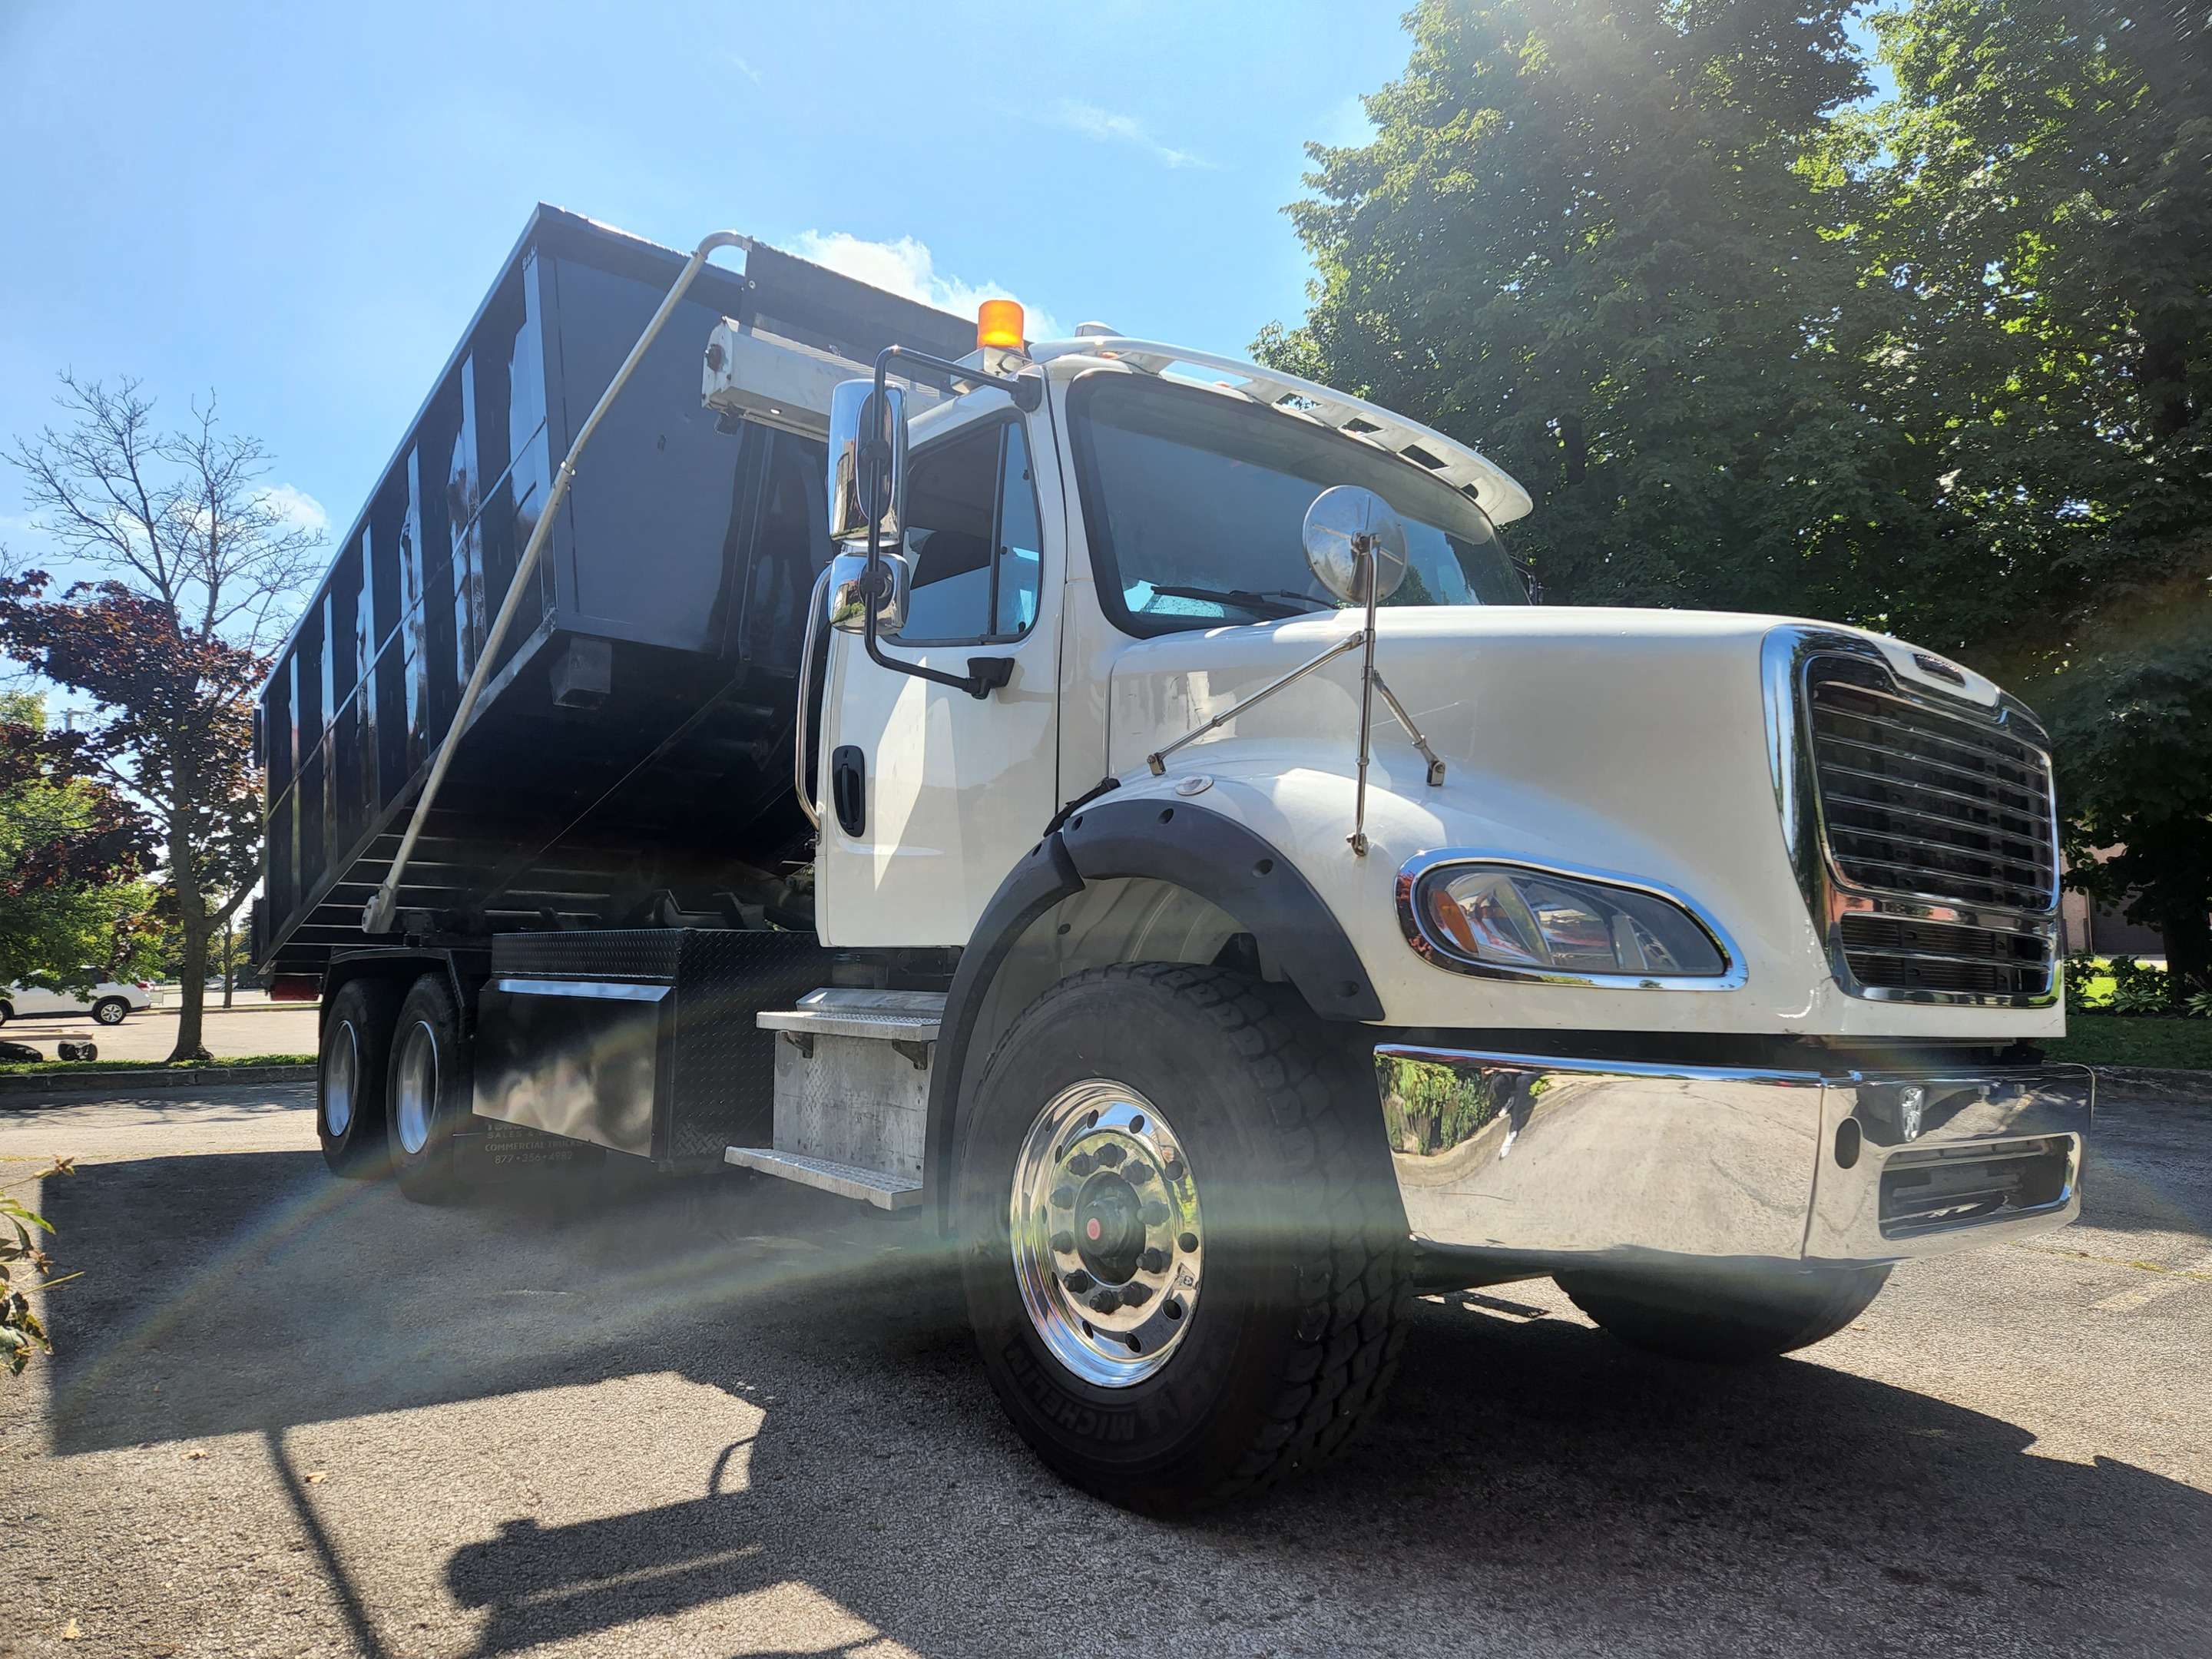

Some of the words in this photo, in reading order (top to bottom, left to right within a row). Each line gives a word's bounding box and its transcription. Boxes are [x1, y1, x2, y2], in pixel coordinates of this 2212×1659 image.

[485, 1130, 522, 1139] SALES
[485, 1141, 546, 1152] COMMERCIAL
[1005, 1341, 1136, 1441] MICHELIN
